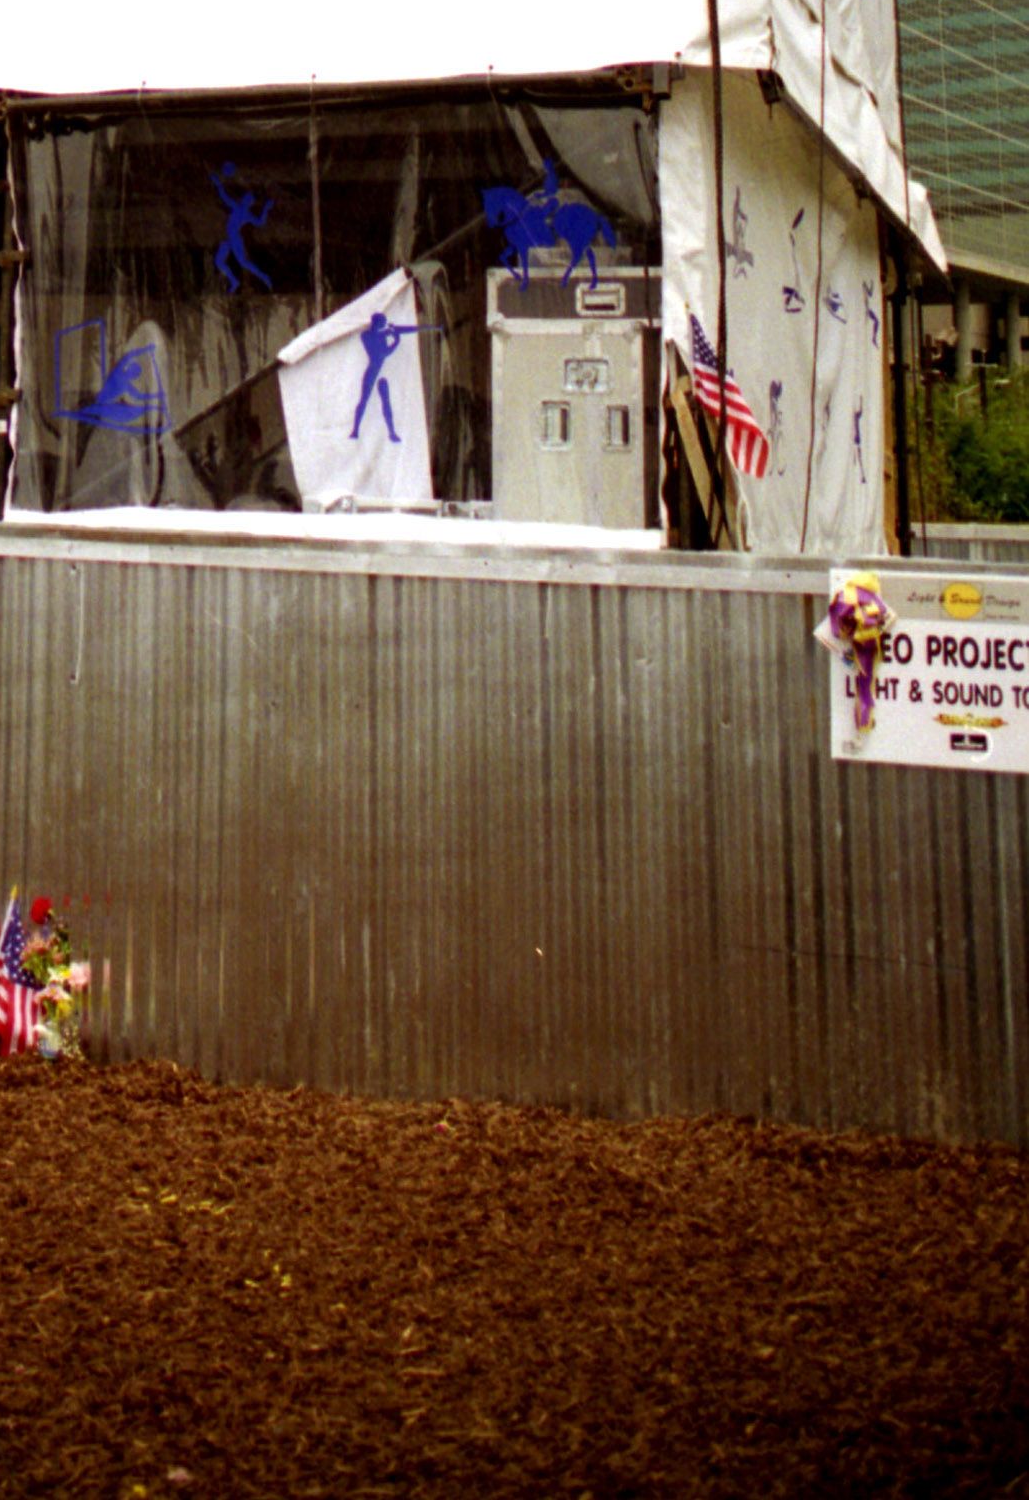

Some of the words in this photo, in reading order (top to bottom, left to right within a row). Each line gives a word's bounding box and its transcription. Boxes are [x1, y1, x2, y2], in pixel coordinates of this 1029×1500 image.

[846, 675, 899, 700] LHT
[909, 679, 922, 703] &
[933, 680, 1003, 707] SOUND
